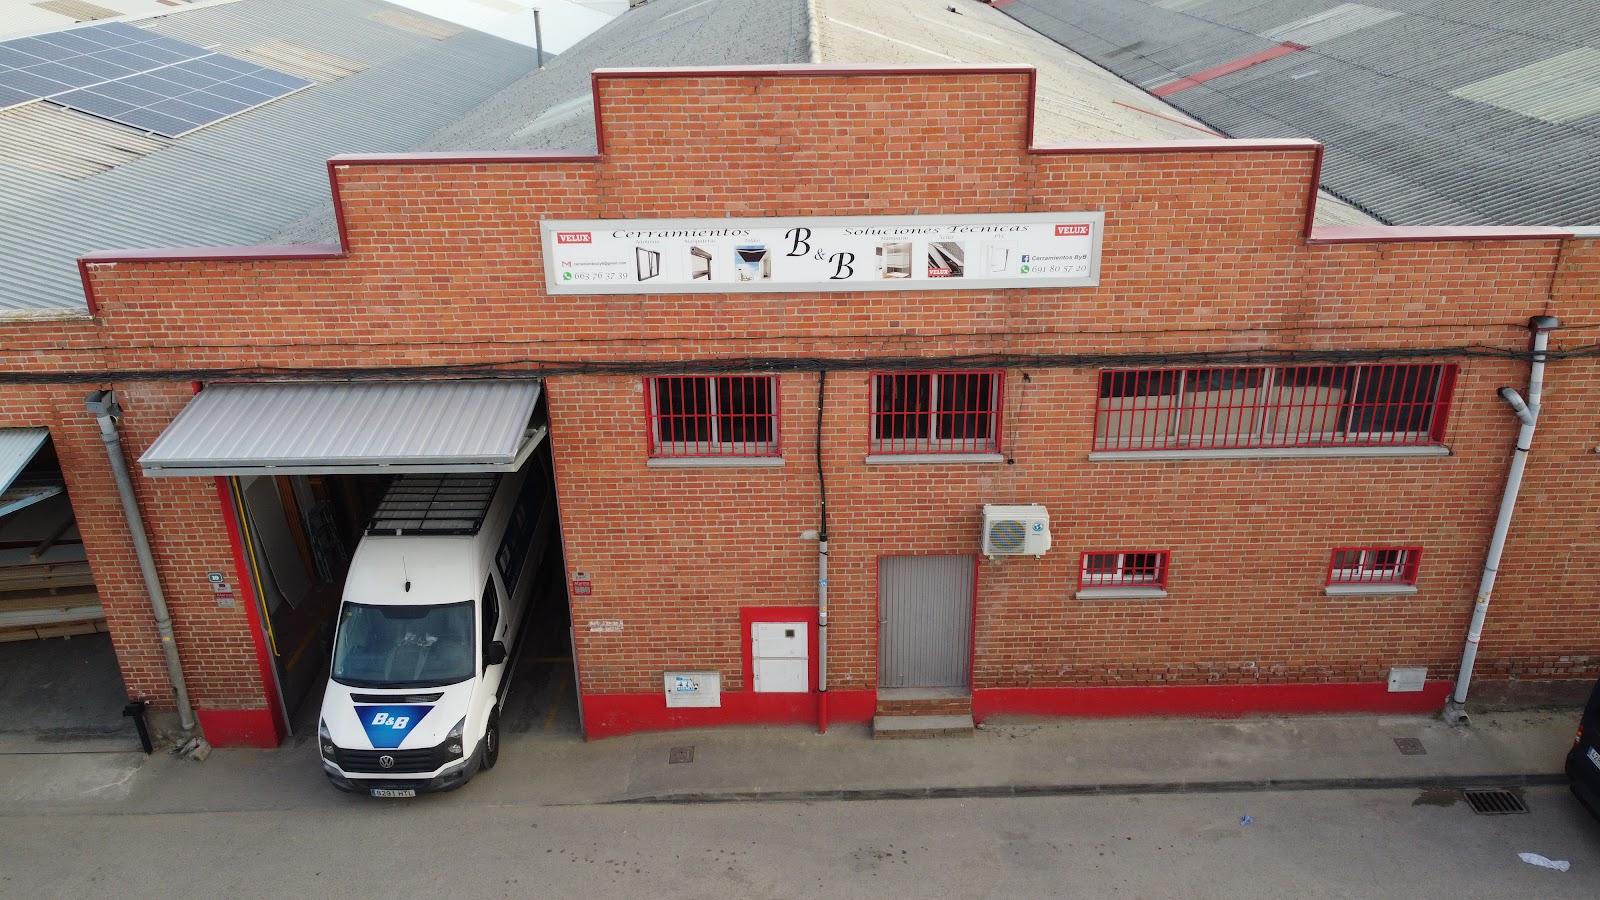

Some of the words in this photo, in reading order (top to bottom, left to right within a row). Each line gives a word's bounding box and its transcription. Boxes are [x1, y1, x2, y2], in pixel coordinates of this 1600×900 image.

[612, 228, 751, 239] Cerramientos
[843, 226, 940, 236] Soluciones
[947, 224, 1029, 234] Técnicas
[1058, 226, 1087, 234] VELUX
[559, 234, 590, 242] VELUX
[1031, 265, 1047, 274] 691
[1049, 264, 1060, 273] 80
[1063, 265, 1074, 273] 57
[574, 272, 590, 281] 663
[605, 272, 615, 280] 37
[618, 272, 628, 280] 39
[371, 712, 410, 730] B&B
